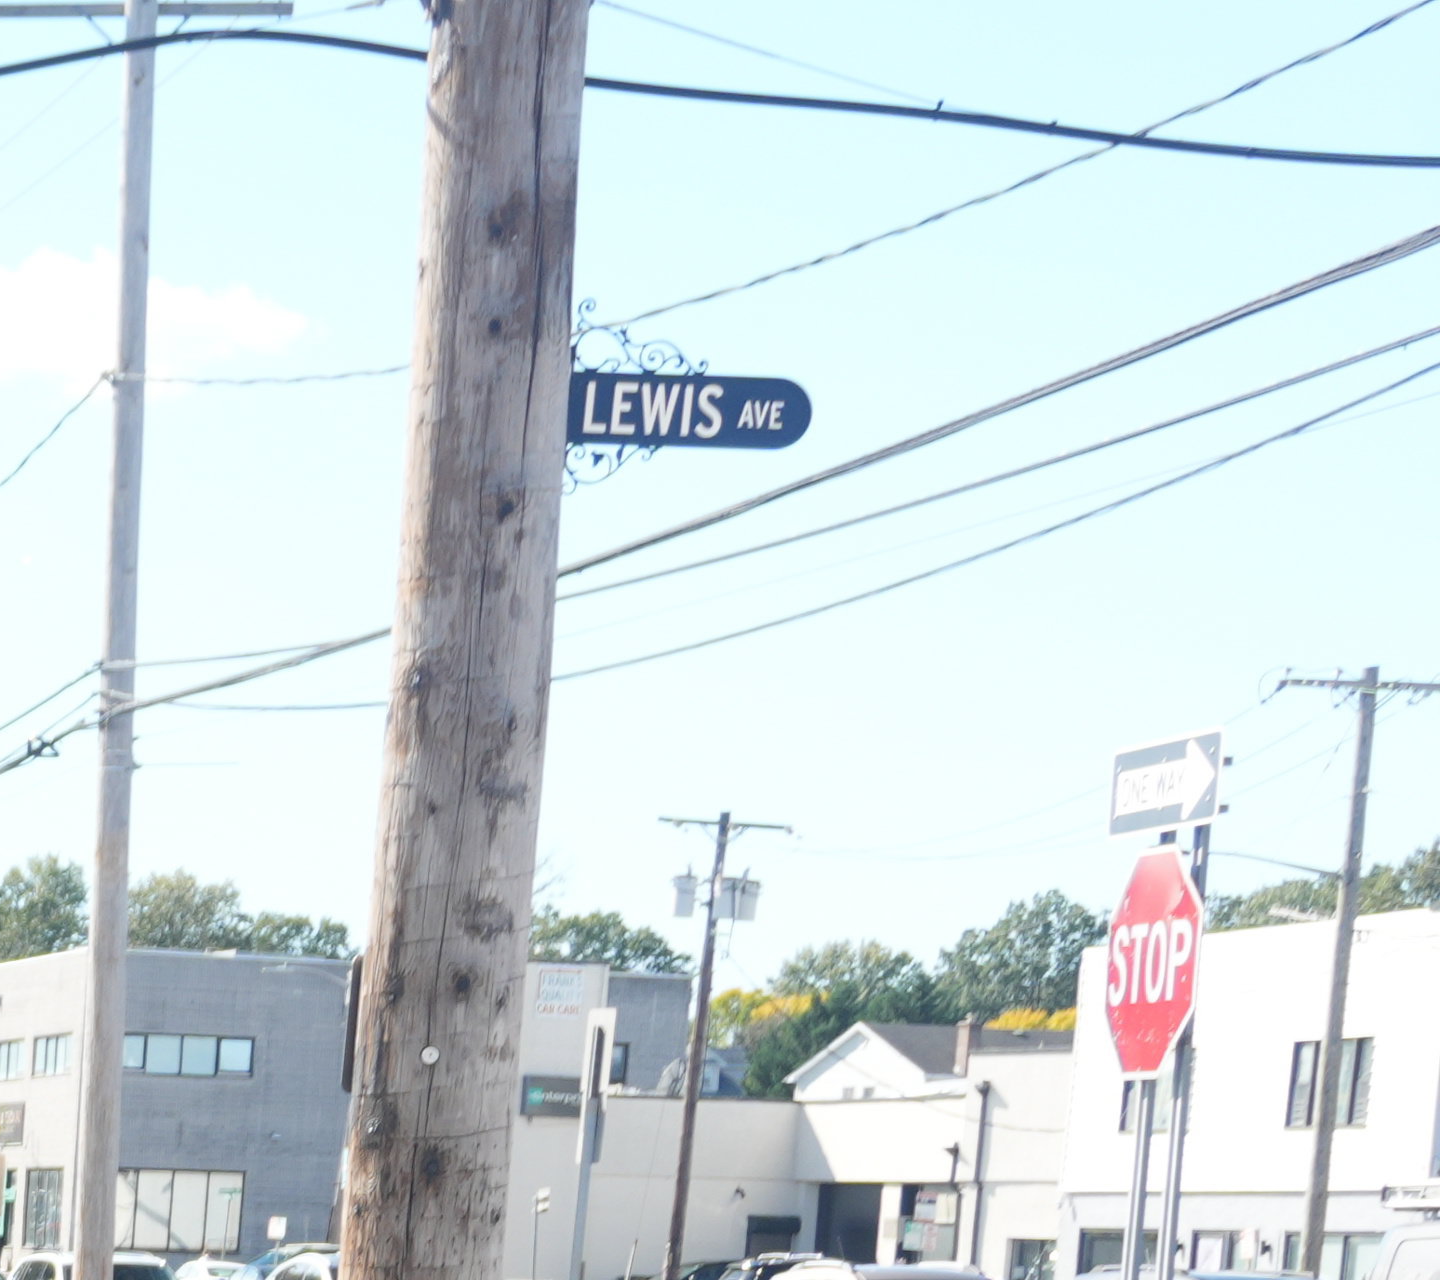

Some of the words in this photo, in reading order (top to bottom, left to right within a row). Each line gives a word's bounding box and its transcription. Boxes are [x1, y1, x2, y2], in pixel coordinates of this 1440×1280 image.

[582, 380, 724, 439] LEWIS
[736, 400, 785, 430] AVE
[1121, 773, 1151, 808] ONE
[1155, 764, 1185, 800] WAY
[1107, 918, 1193, 1007] STOP
[537, 1003, 556, 1014] CAR
